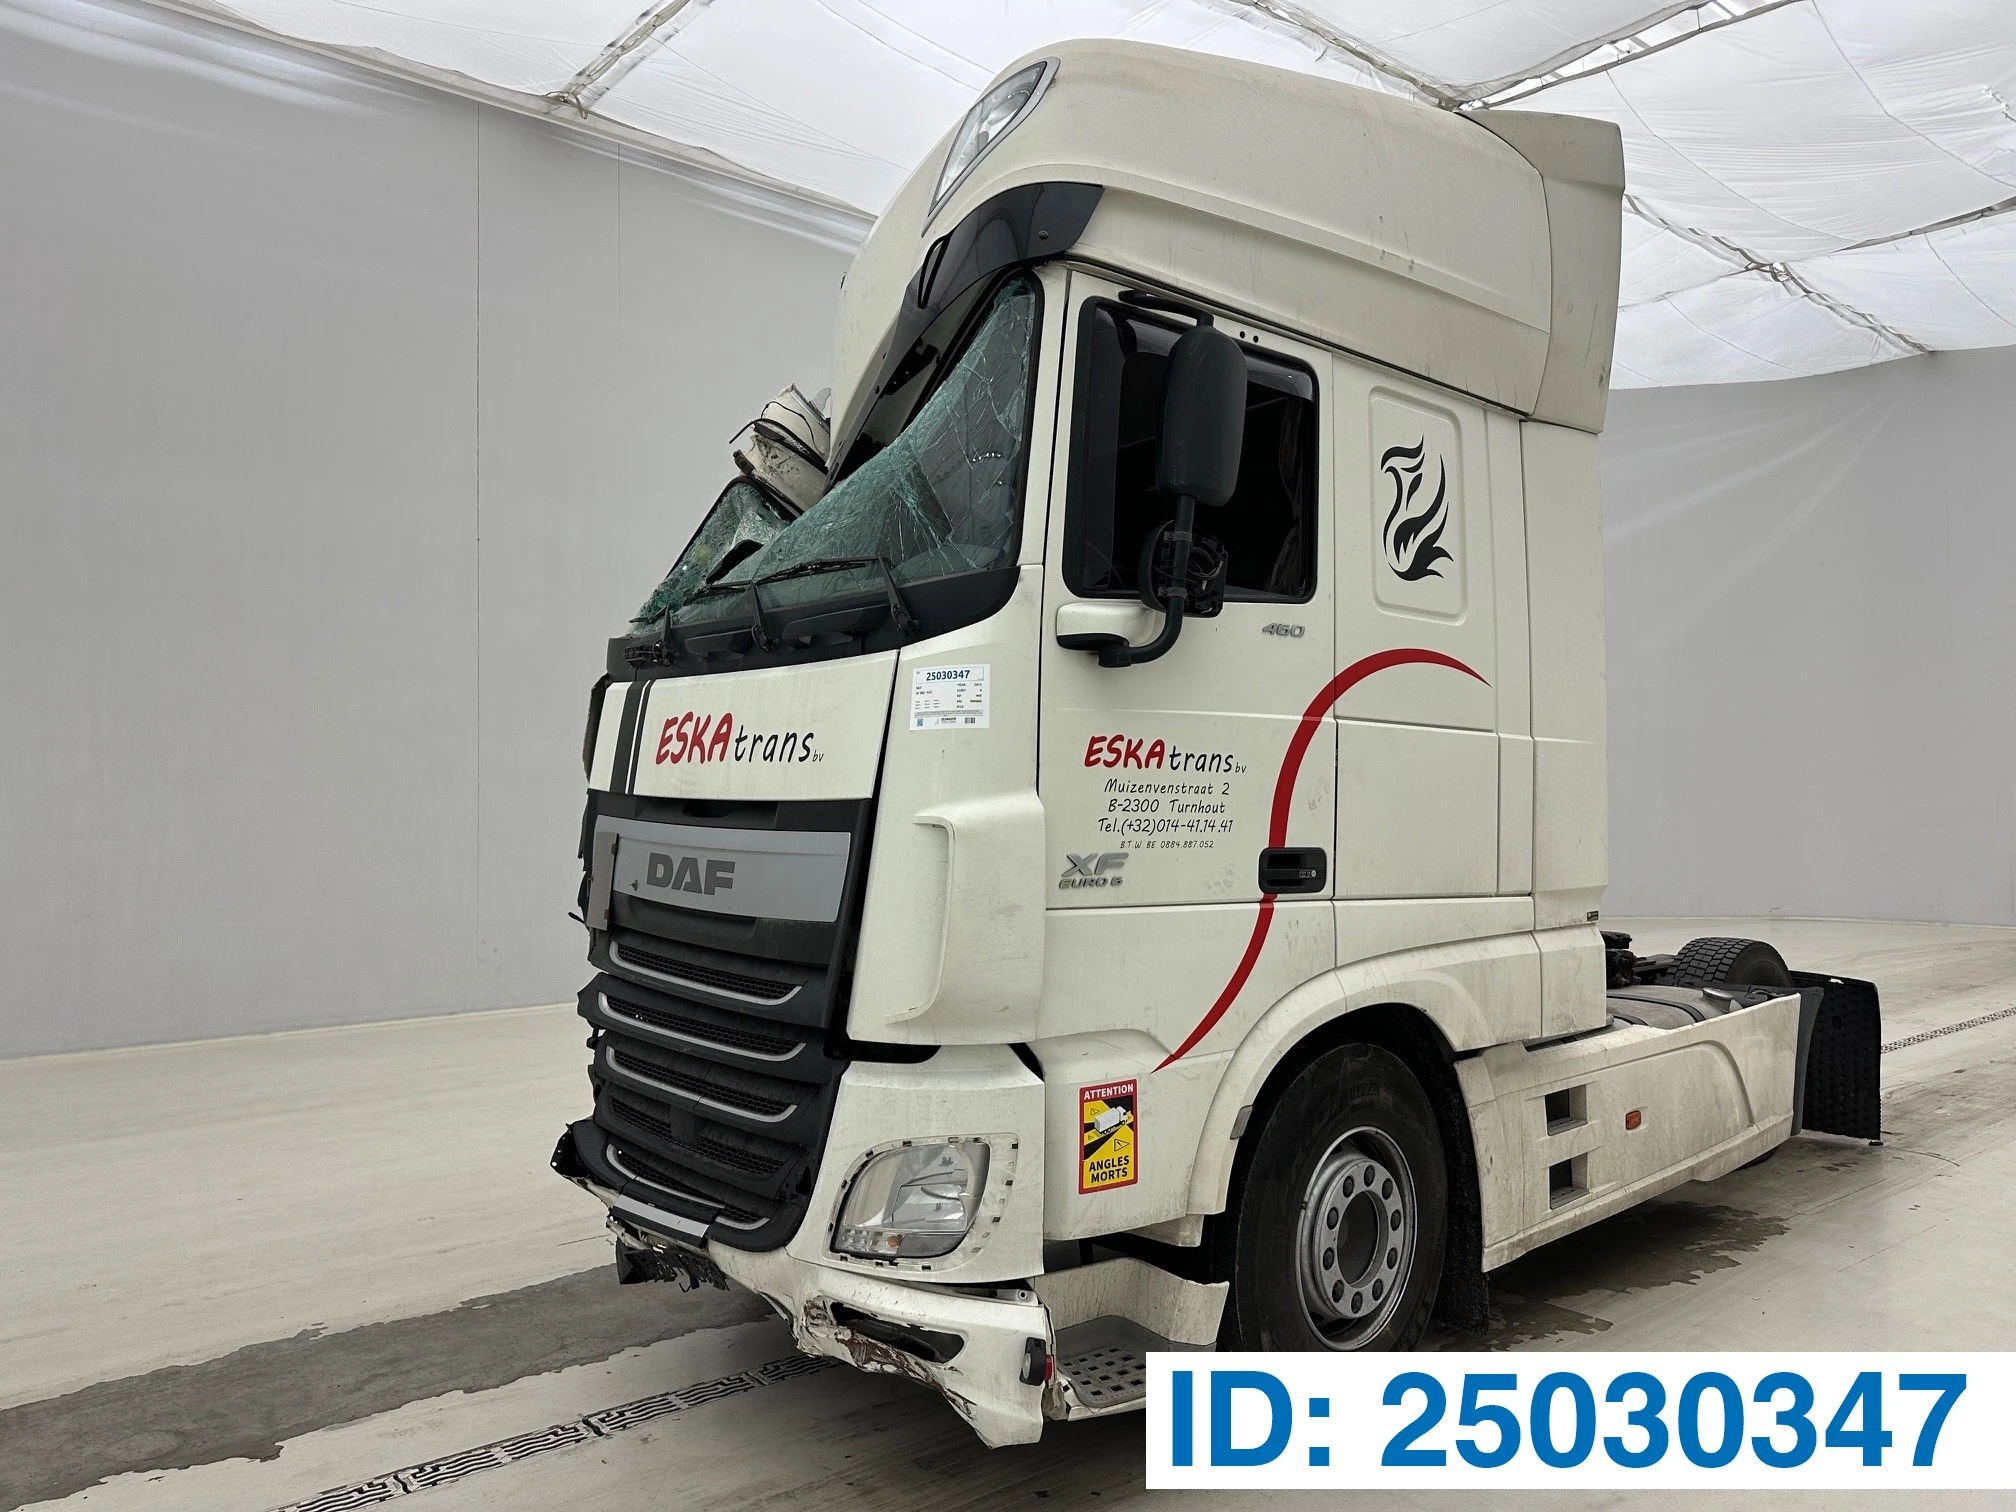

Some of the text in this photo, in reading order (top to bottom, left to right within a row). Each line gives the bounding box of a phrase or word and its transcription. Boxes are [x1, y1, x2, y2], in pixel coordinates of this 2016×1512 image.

[1262, 622, 1306, 638] 460
[926, 669, 971, 681] 25030347
[812, 749, 824, 763] bv
[1234, 764, 1247, 774] bv
[1104, 778, 1230, 796] Muizenvenstraat 2
[1108, 798, 1226, 814] B-2300 Turnhout
[1146, 840, 1157, 849] BE
[1160, 840, 1214, 849] 0884.887.052
[1061, 852, 1130, 877] XF
[646, 852, 736, 896] DAF
[1058, 876, 1123, 889] EURO 6
[1083, 1083, 1134, 1100] ATTENTION
[1088, 1155, 1130, 1172] ANGLES
[1090, 1167, 1128, 1184] MORTS
